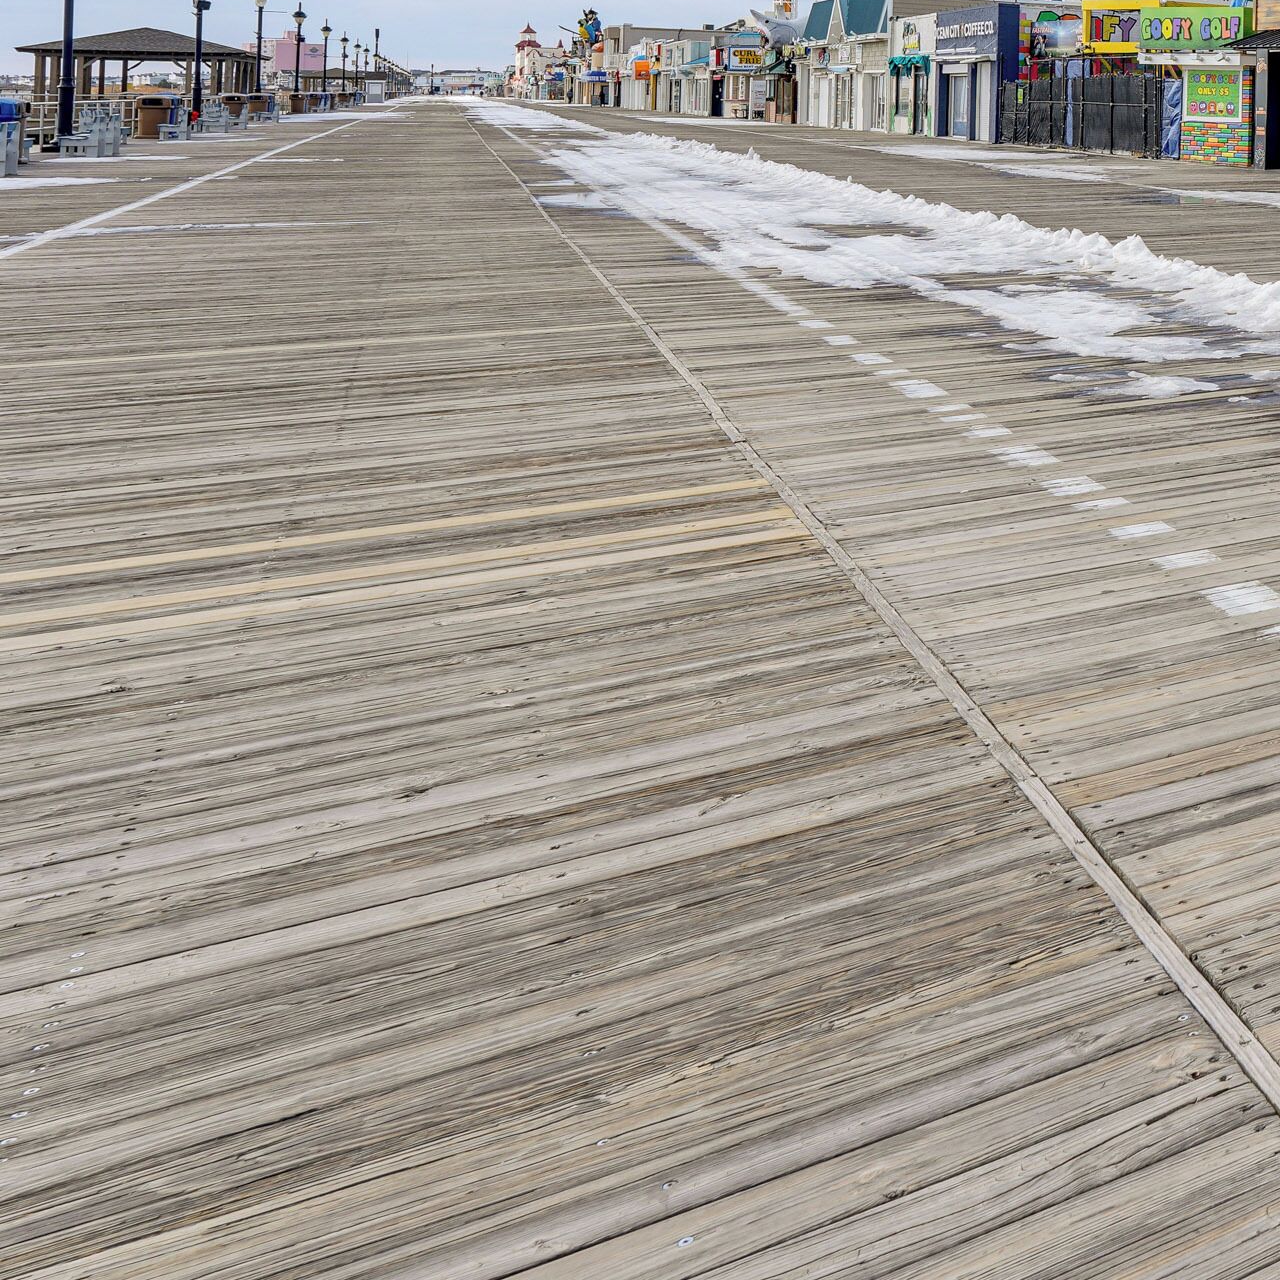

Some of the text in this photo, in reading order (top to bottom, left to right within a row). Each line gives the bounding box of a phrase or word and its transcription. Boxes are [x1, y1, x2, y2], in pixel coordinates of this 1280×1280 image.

[936, 25, 950, 40] CEAN
[949, 24, 961, 38] CITY
[964, 22, 985, 37] COFFEE
[1141, 16, 1240, 41] GOOFY GOLF
[738, 57, 762, 65] FRIE
[1190, 73, 1240, 84] GOOFY GOLF
[1197, 87, 1229, 96] ONLY $5
